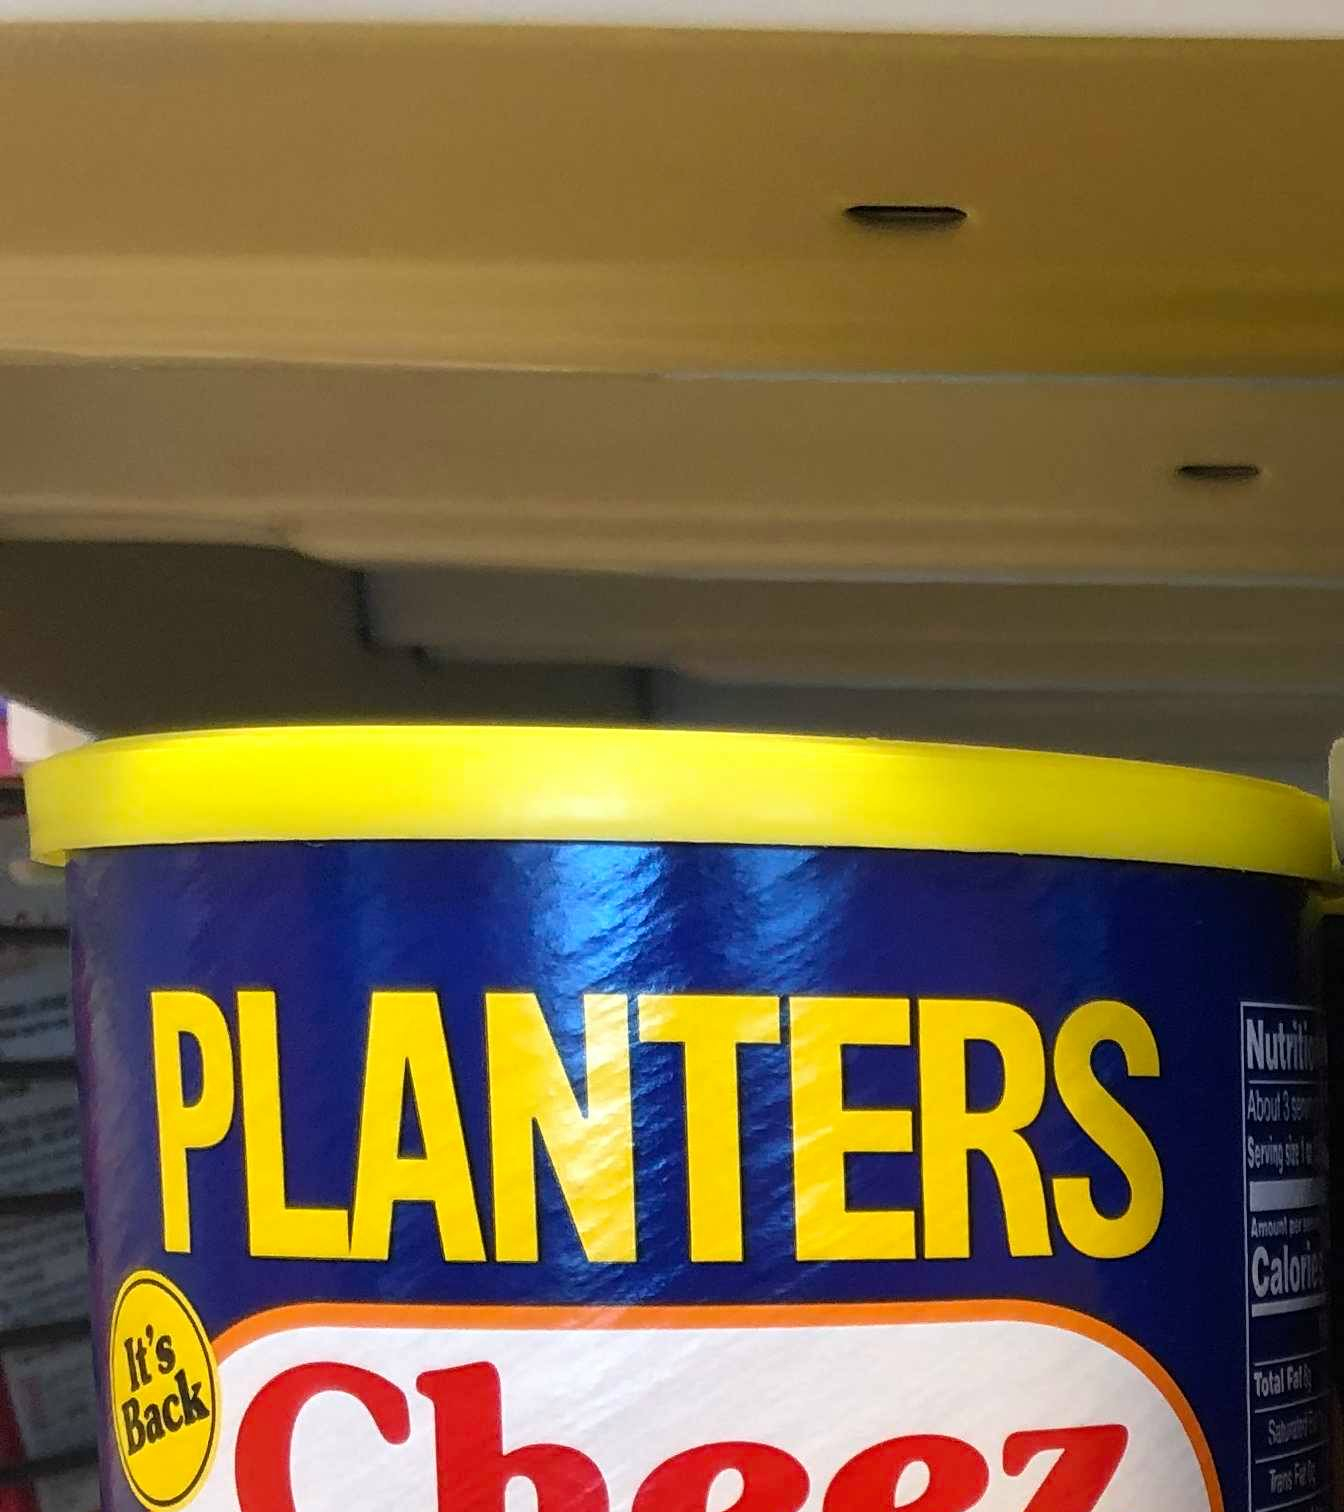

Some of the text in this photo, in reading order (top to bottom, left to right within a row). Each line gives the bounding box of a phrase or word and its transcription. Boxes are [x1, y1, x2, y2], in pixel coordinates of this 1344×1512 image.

[150, 990, 1164, 1262] PLANTERS
[1247, 1088, 1280, 1122] About
[1247, 1134, 1283, 1174] Serving
[124, 1324, 175, 1392] It's
[1253, 1367, 1284, 1398] Total
[122, 1372, 210, 1455] Back
